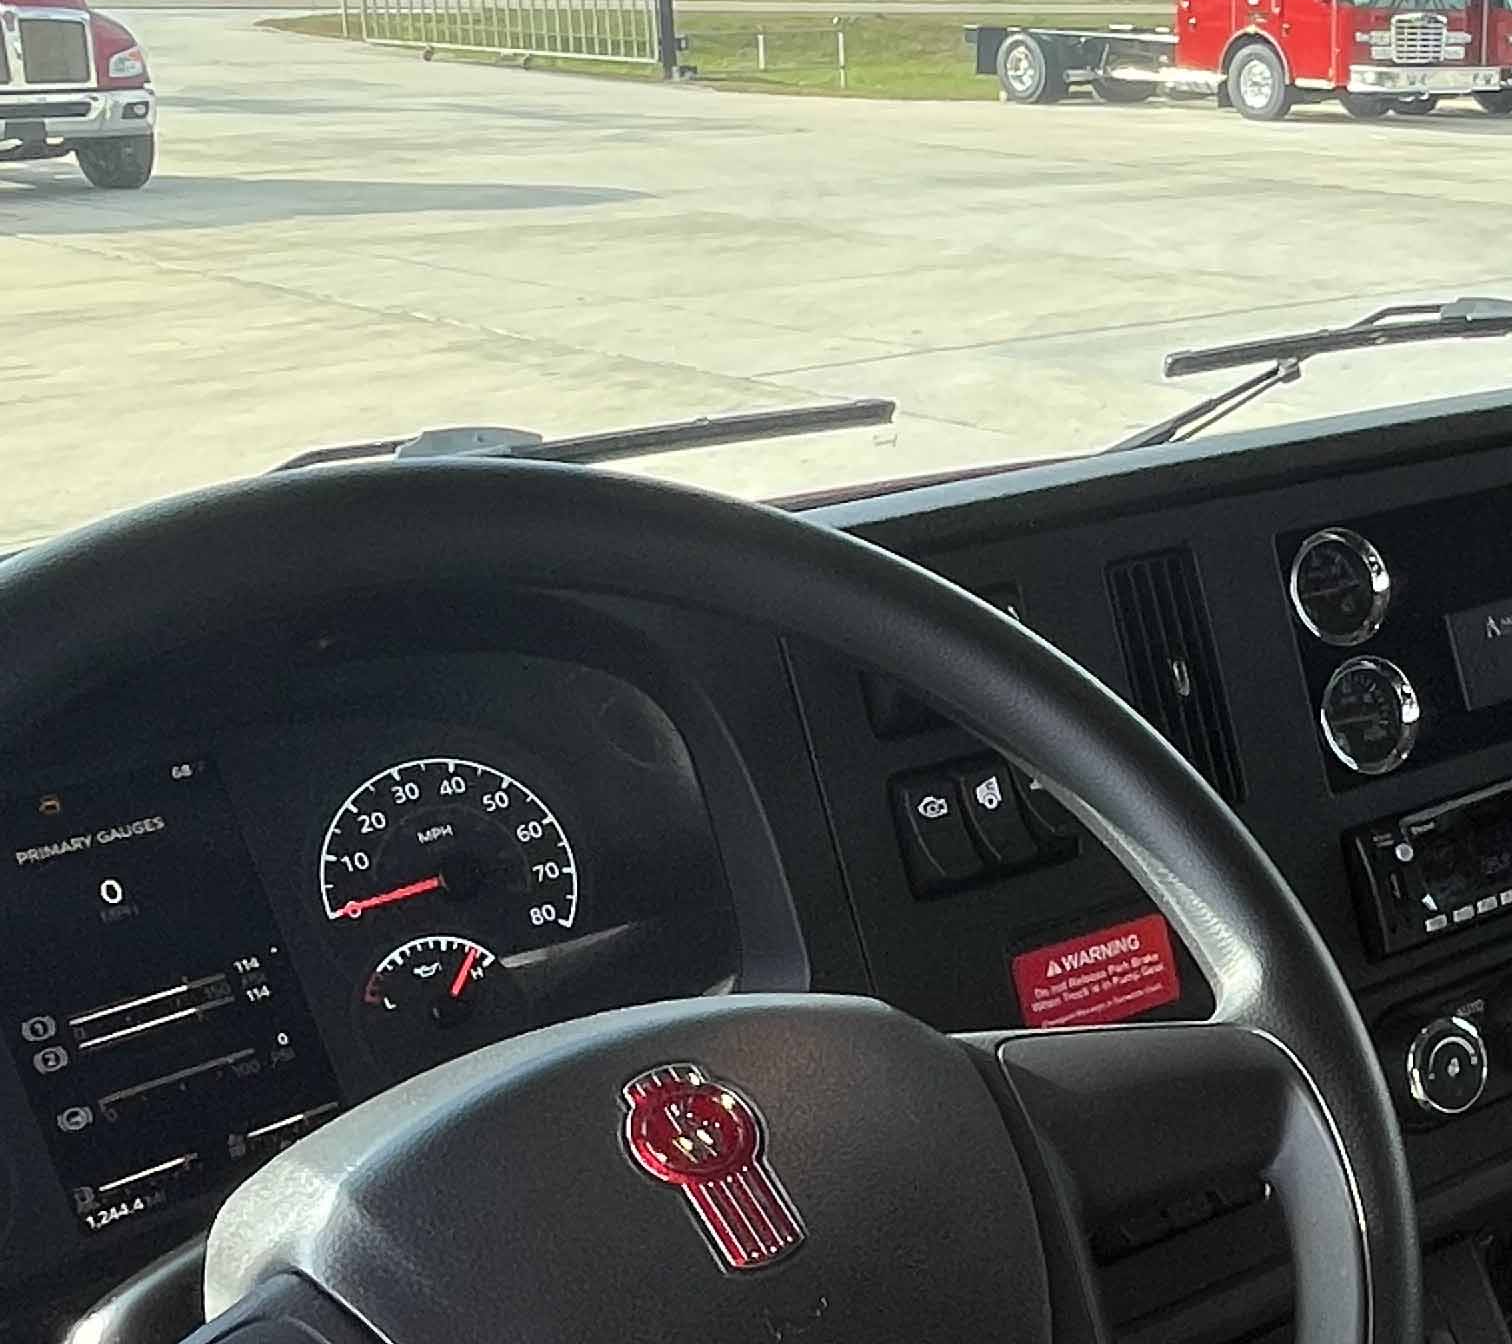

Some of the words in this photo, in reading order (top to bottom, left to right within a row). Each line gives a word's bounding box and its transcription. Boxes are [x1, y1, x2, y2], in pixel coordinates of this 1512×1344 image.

[391, 782, 420, 804] 30
[440, 776, 466, 795] 40
[482, 790, 509, 813] 50
[357, 812, 386, 834] 20
[516, 820, 543, 843] 60
[15, 834, 93, 865] PRIMARY
[96, 816, 166, 844] GAUGES
[417, 824, 454, 844] MPH
[341, 852, 370, 873] 10
[532, 862, 560, 883] 70
[100, 879, 123, 904] 0
[529, 904, 556, 926] 80
[1061, 934, 1141, 972] WARNING
[233, 957, 260, 974] 114
[470, 966, 485, 980] H
[246, 984, 271, 1002] 114
[383, 996, 397, 1010] L
[1034, 987, 1050, 1000] Do
[277, 1032, 289, 1045] 0
